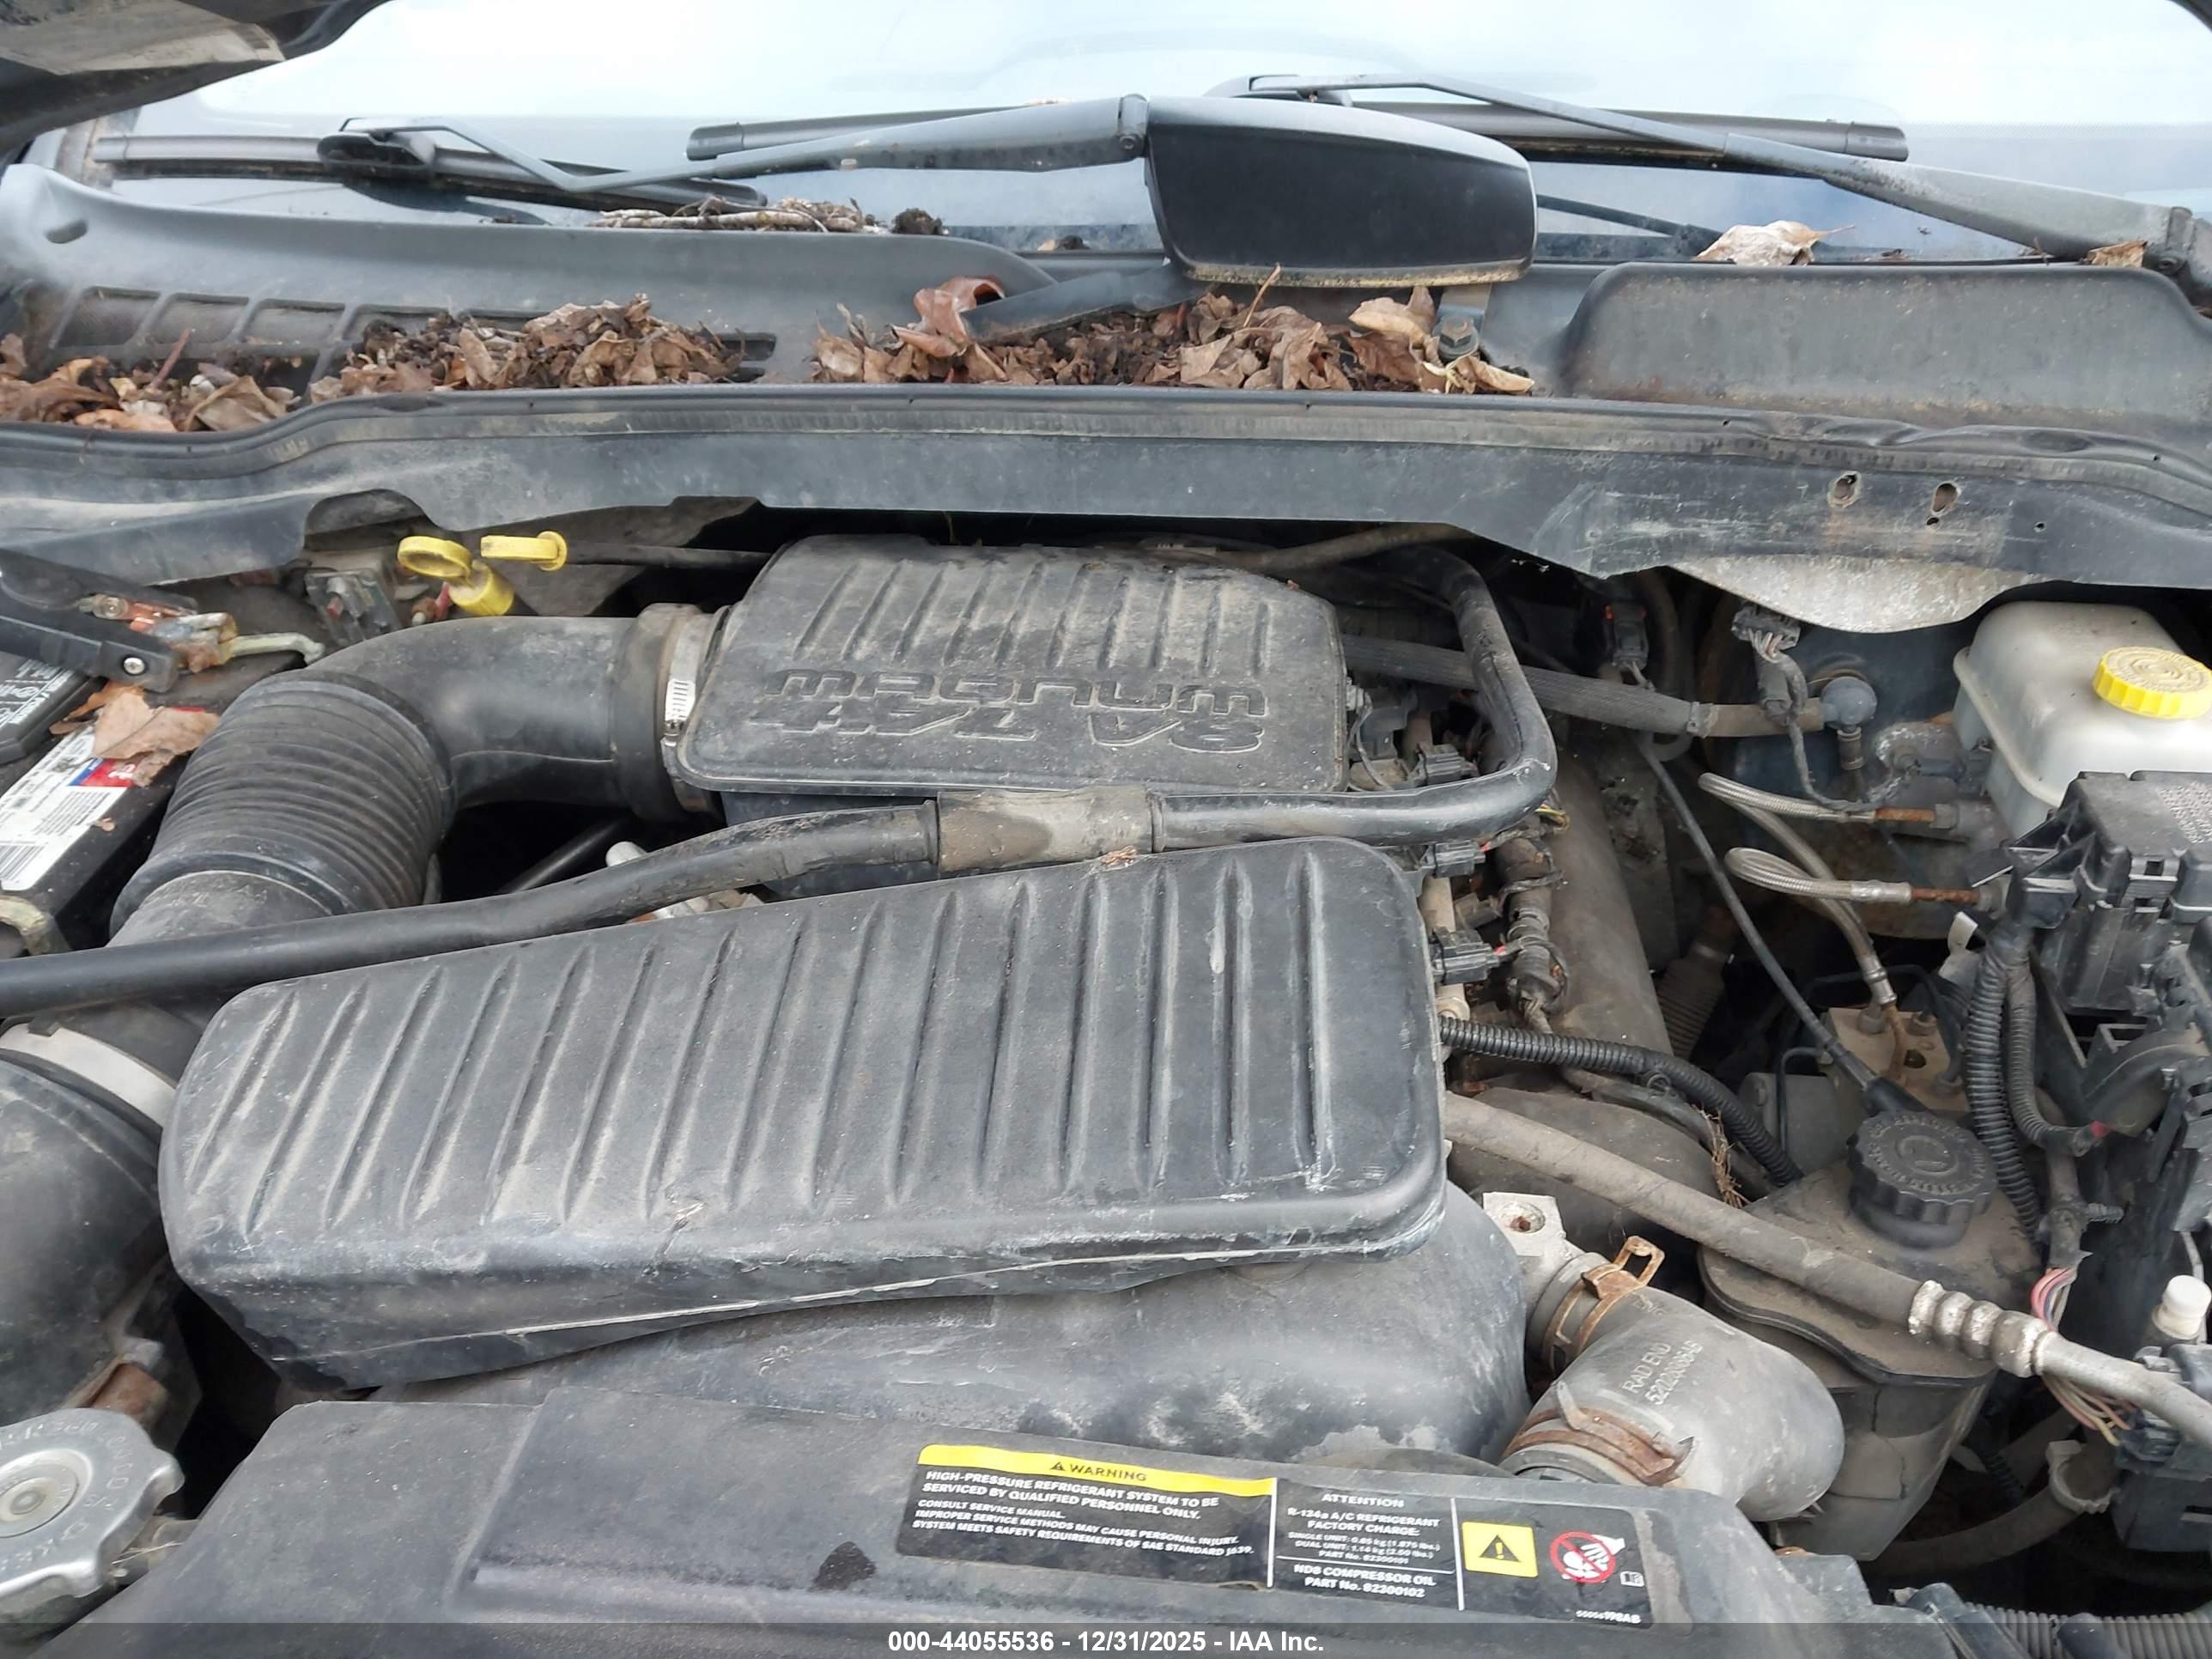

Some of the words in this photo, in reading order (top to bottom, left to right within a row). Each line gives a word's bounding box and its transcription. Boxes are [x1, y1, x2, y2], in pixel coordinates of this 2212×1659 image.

[1070, 1463, 1148, 1482] WARNING
[926, 1471, 1033, 1489] HIGH-PRESSURE
[1034, 1480, 1126, 1498] REFRIGERANT
[1127, 1491, 1180, 1506] SYSTEM
[1181, 1498, 1201, 1507] TO
[1201, 1497, 1219, 1507] BE
[918, 1499, 969, 1510] CONSULT
[969, 1503, 1016, 1514] SERVICE
[1016, 1508, 1066, 1518] MANUAL.
[922, 1483, 988, 1495] SERVICED
[989, 1488, 1007, 1498] BY
[1008, 1490, 1079, 1505] QUALIFIED
[1080, 1498, 1160, 1514] PERSONNEL
[1163, 1508, 1201, 1519] ONLY.
[1321, 1493, 1405, 1508] ATTENTION
[915, 1510, 971, 1520] IMPROPER
[972, 1513, 1019, 1524] SERVICE
[1019, 1518, 1074, 1530] METHODS
[1075, 1523, 1100, 1534] MAY
[1101, 1527, 1139, 1538] CAUSE
[1139, 1530, 1197, 1544] PERSONAL
[1198, 1535, 1239, 1547] INJURY.
[1307, 1520, 1364, 1532] FACTORY
[1330, 1512, 1355, 1522] A/C
[1356, 1513, 1441, 1528] REFRIGERANT
[912, 1520, 956, 1530] SYSTEM
[957, 1522, 994, 1534] MEETS
[994, 1526, 1036, 1538] SAFETY
[1036, 1530, 1124, 1547] REQUIREMENTS
[1125, 1540, 1141, 1549] OF
[1142, 1540, 1164, 1551] SAE
[1164, 1543, 1224, 1556] STANDARD
[1304, 1577, 1339, 1588] PART
[1339, 1580, 1363, 1590] No.
[1322, 1567, 1412, 1583] COMPRESSOR
[1413, 1575, 1437, 1586] OIL
